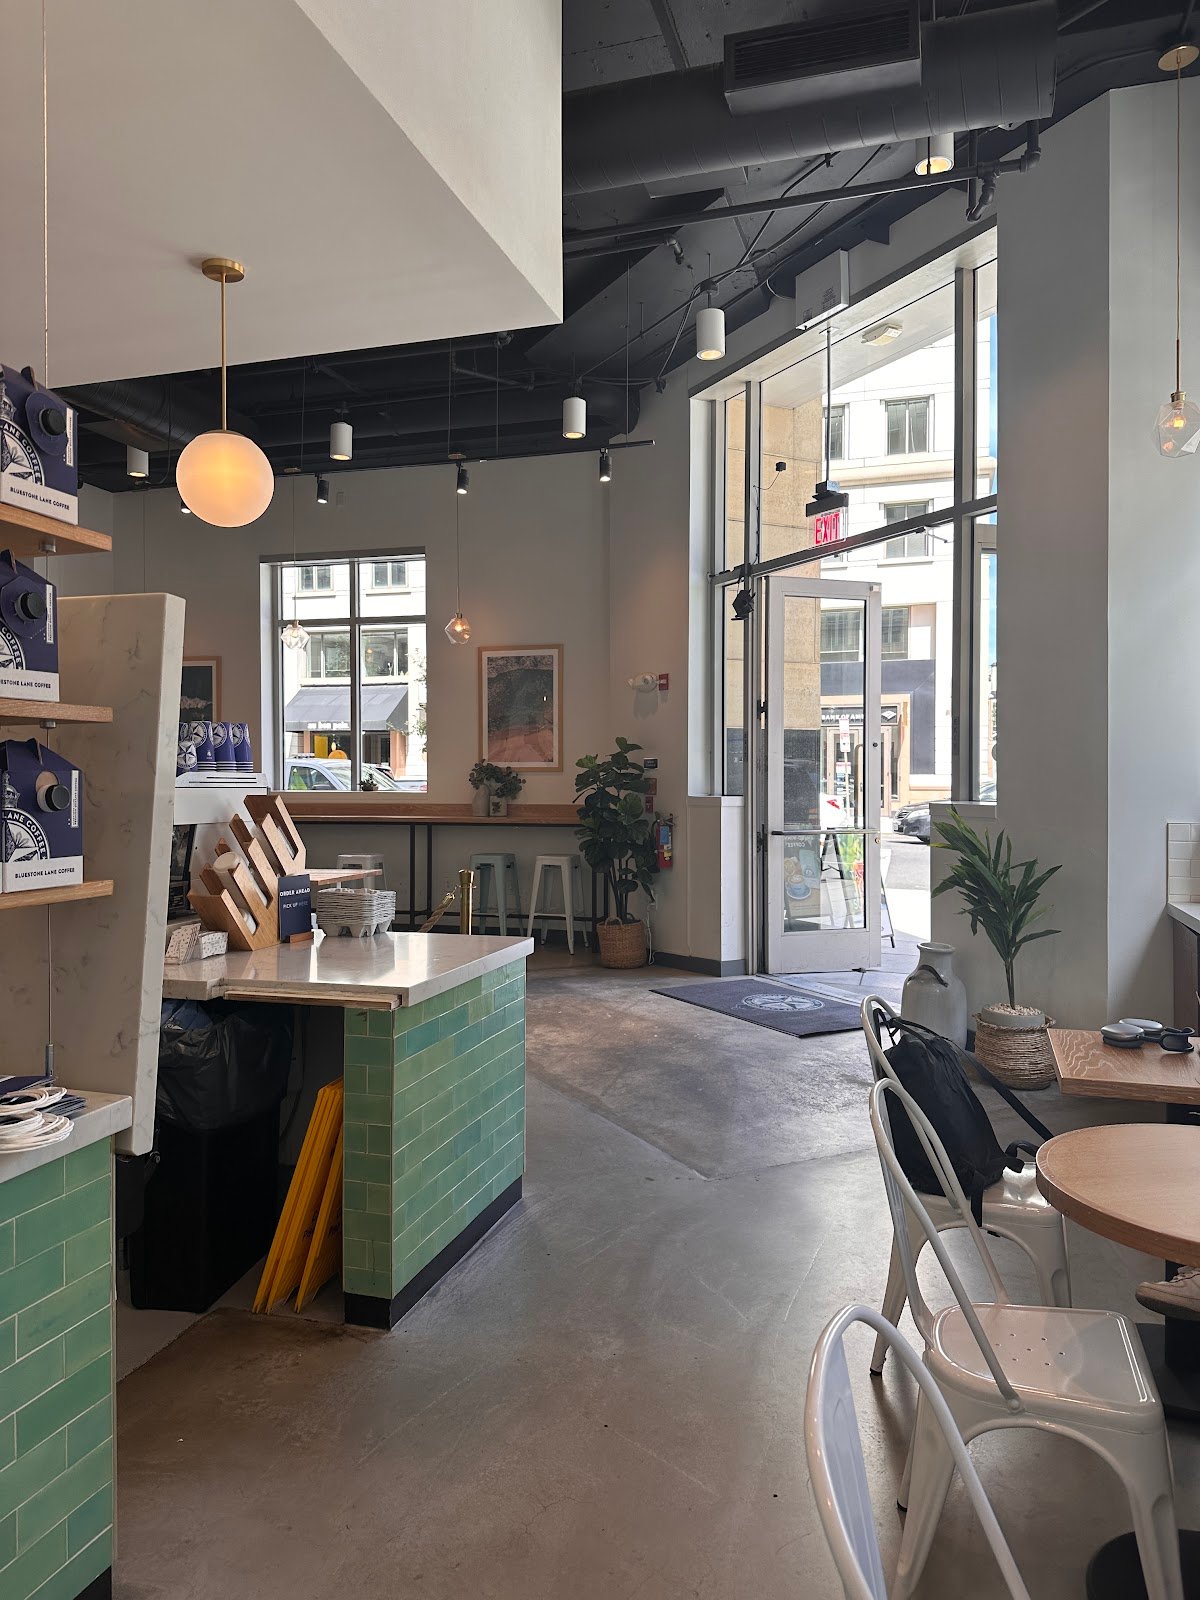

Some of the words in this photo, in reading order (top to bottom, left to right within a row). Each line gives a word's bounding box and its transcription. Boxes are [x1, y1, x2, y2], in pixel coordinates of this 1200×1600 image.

[22, 439, 42, 480] COFFEE
[10, 486, 38, 500] BLUESTONE
[39, 496, 52, 505] LANE
[53, 500, 70, 510] COFFEE
[815, 511, 840, 545] EXIT
[1, 626, 22, 664] COFFEE
[26, 820, 46, 854] COFFEE
[15, 870, 44, 879] BLUESTONE
